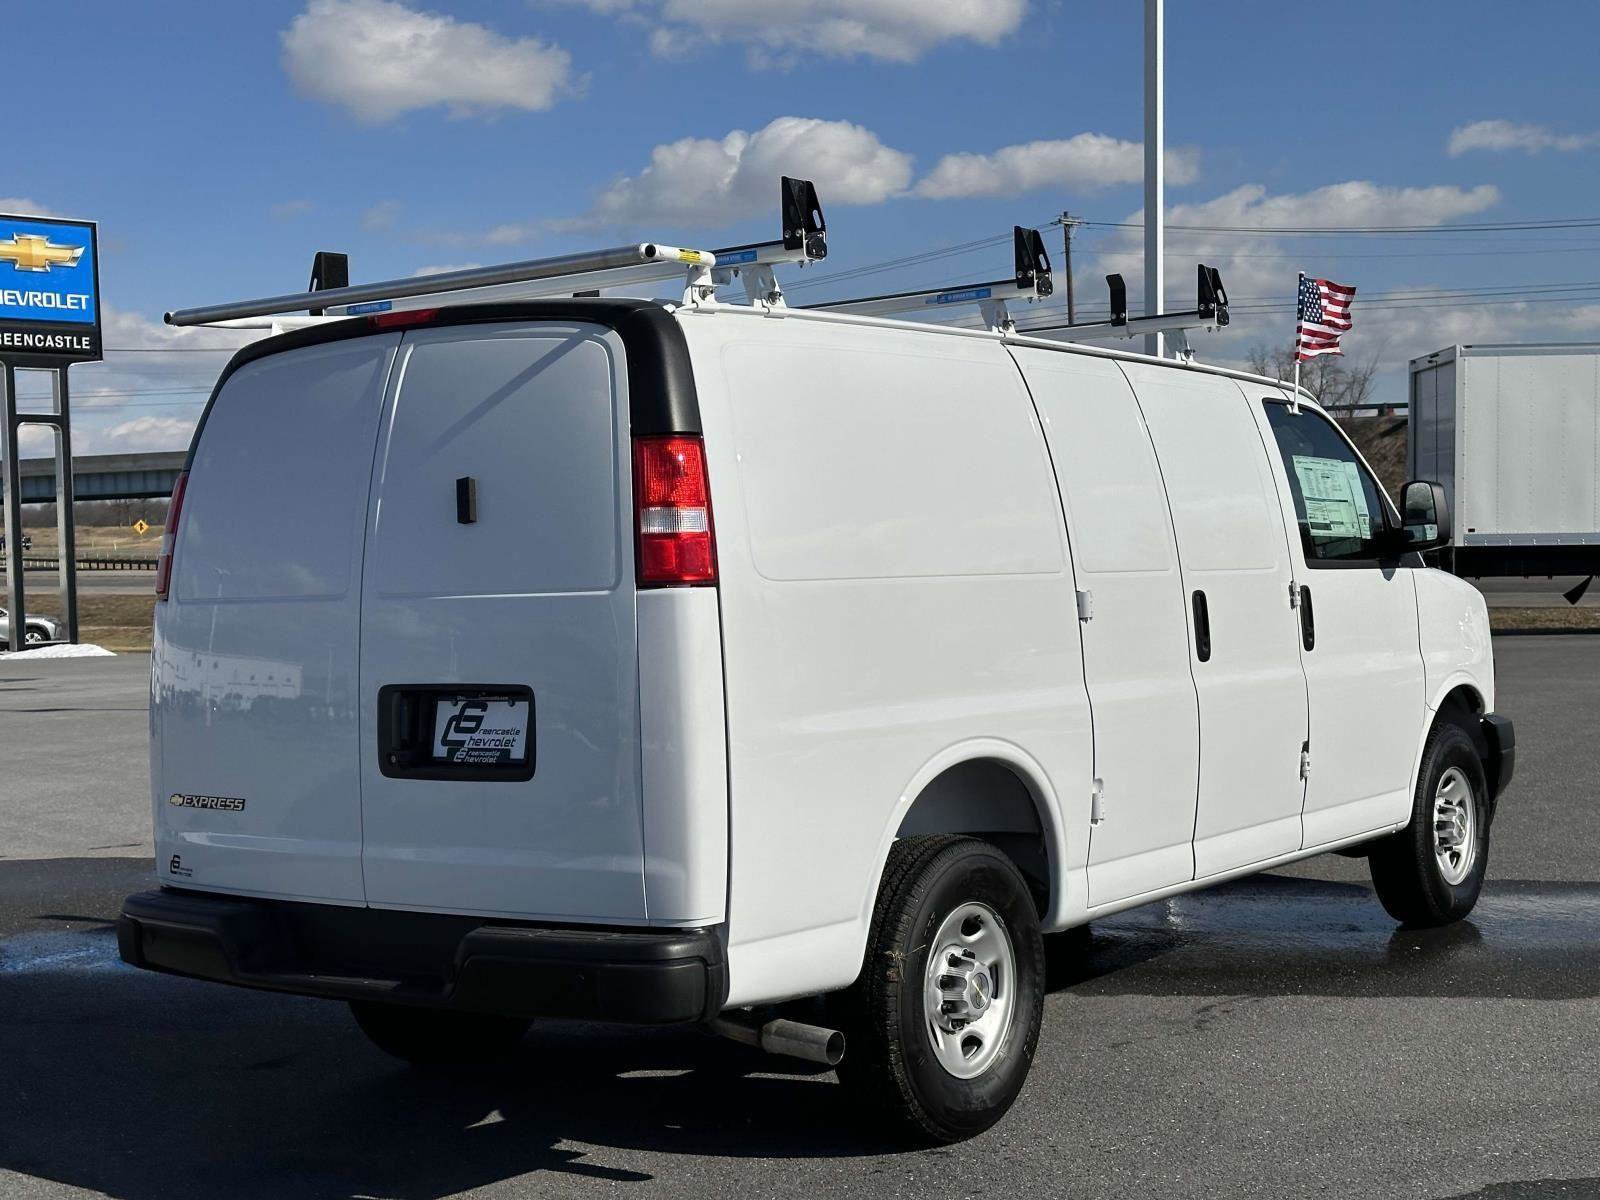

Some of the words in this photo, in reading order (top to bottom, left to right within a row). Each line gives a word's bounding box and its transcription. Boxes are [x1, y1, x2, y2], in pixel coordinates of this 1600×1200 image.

[0, 290, 89, 310] EVROLET
[0, 333, 90, 349] EENCASTLE
[184, 795, 244, 810] EXPRESS
